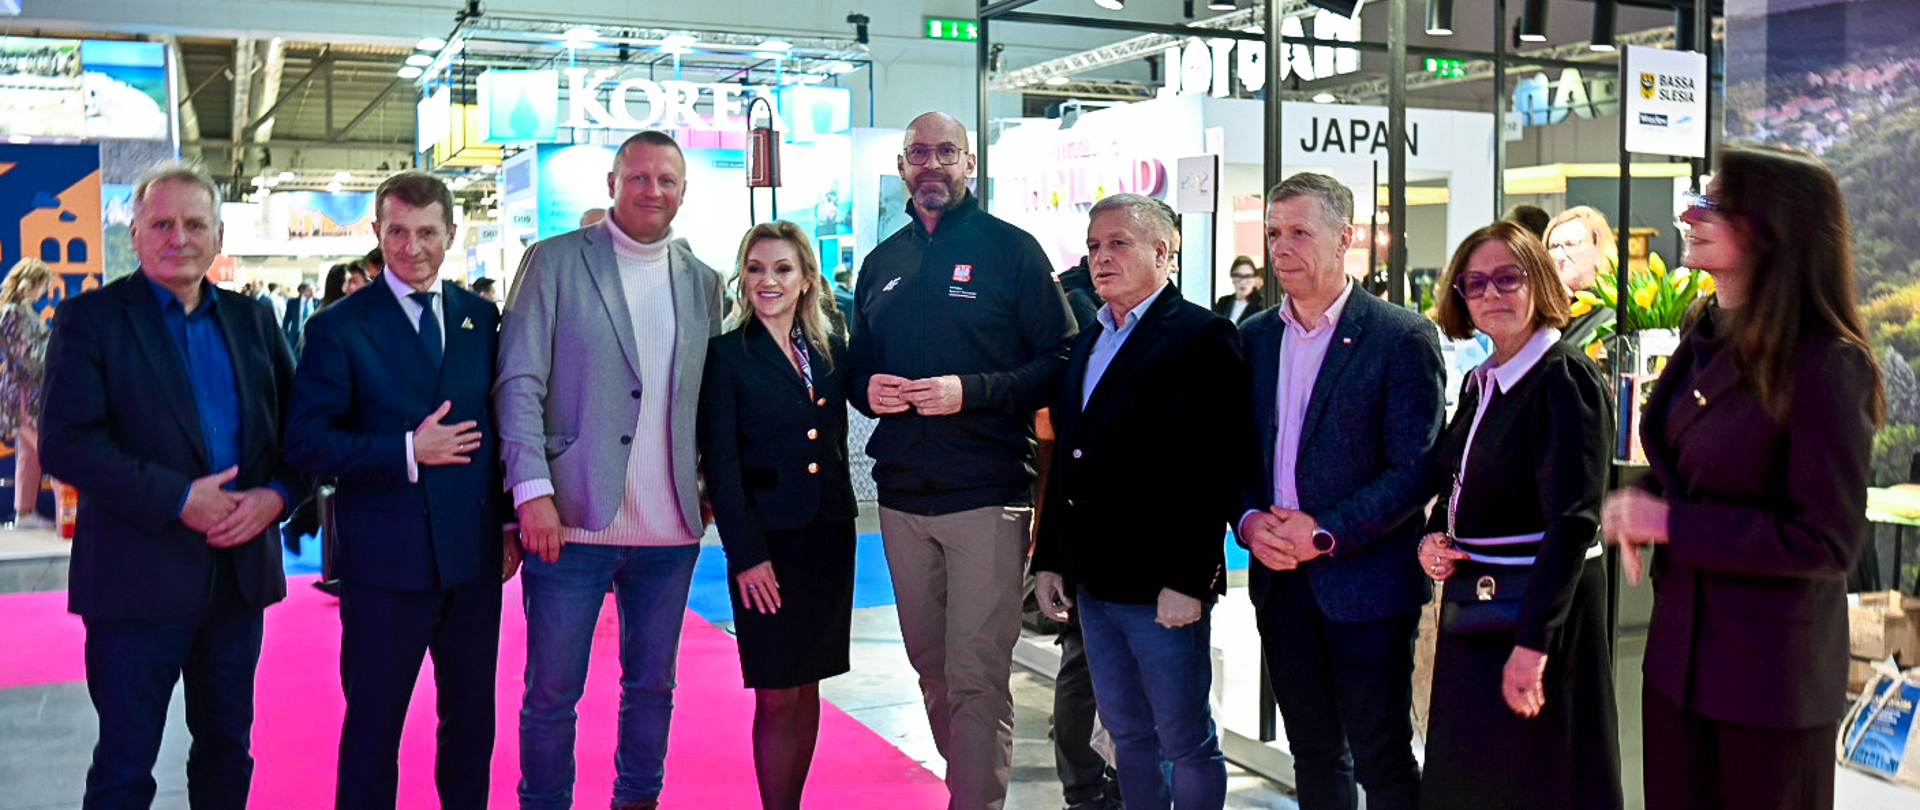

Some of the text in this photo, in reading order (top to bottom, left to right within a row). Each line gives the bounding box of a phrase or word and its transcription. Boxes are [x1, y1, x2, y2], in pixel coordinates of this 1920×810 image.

[1659, 74, 1694, 89] BASSA
[560, 68, 789, 132] KOREA
[1659, 88, 1695, 103] SLESIA
[1300, 117, 1417, 156] JAPAN
